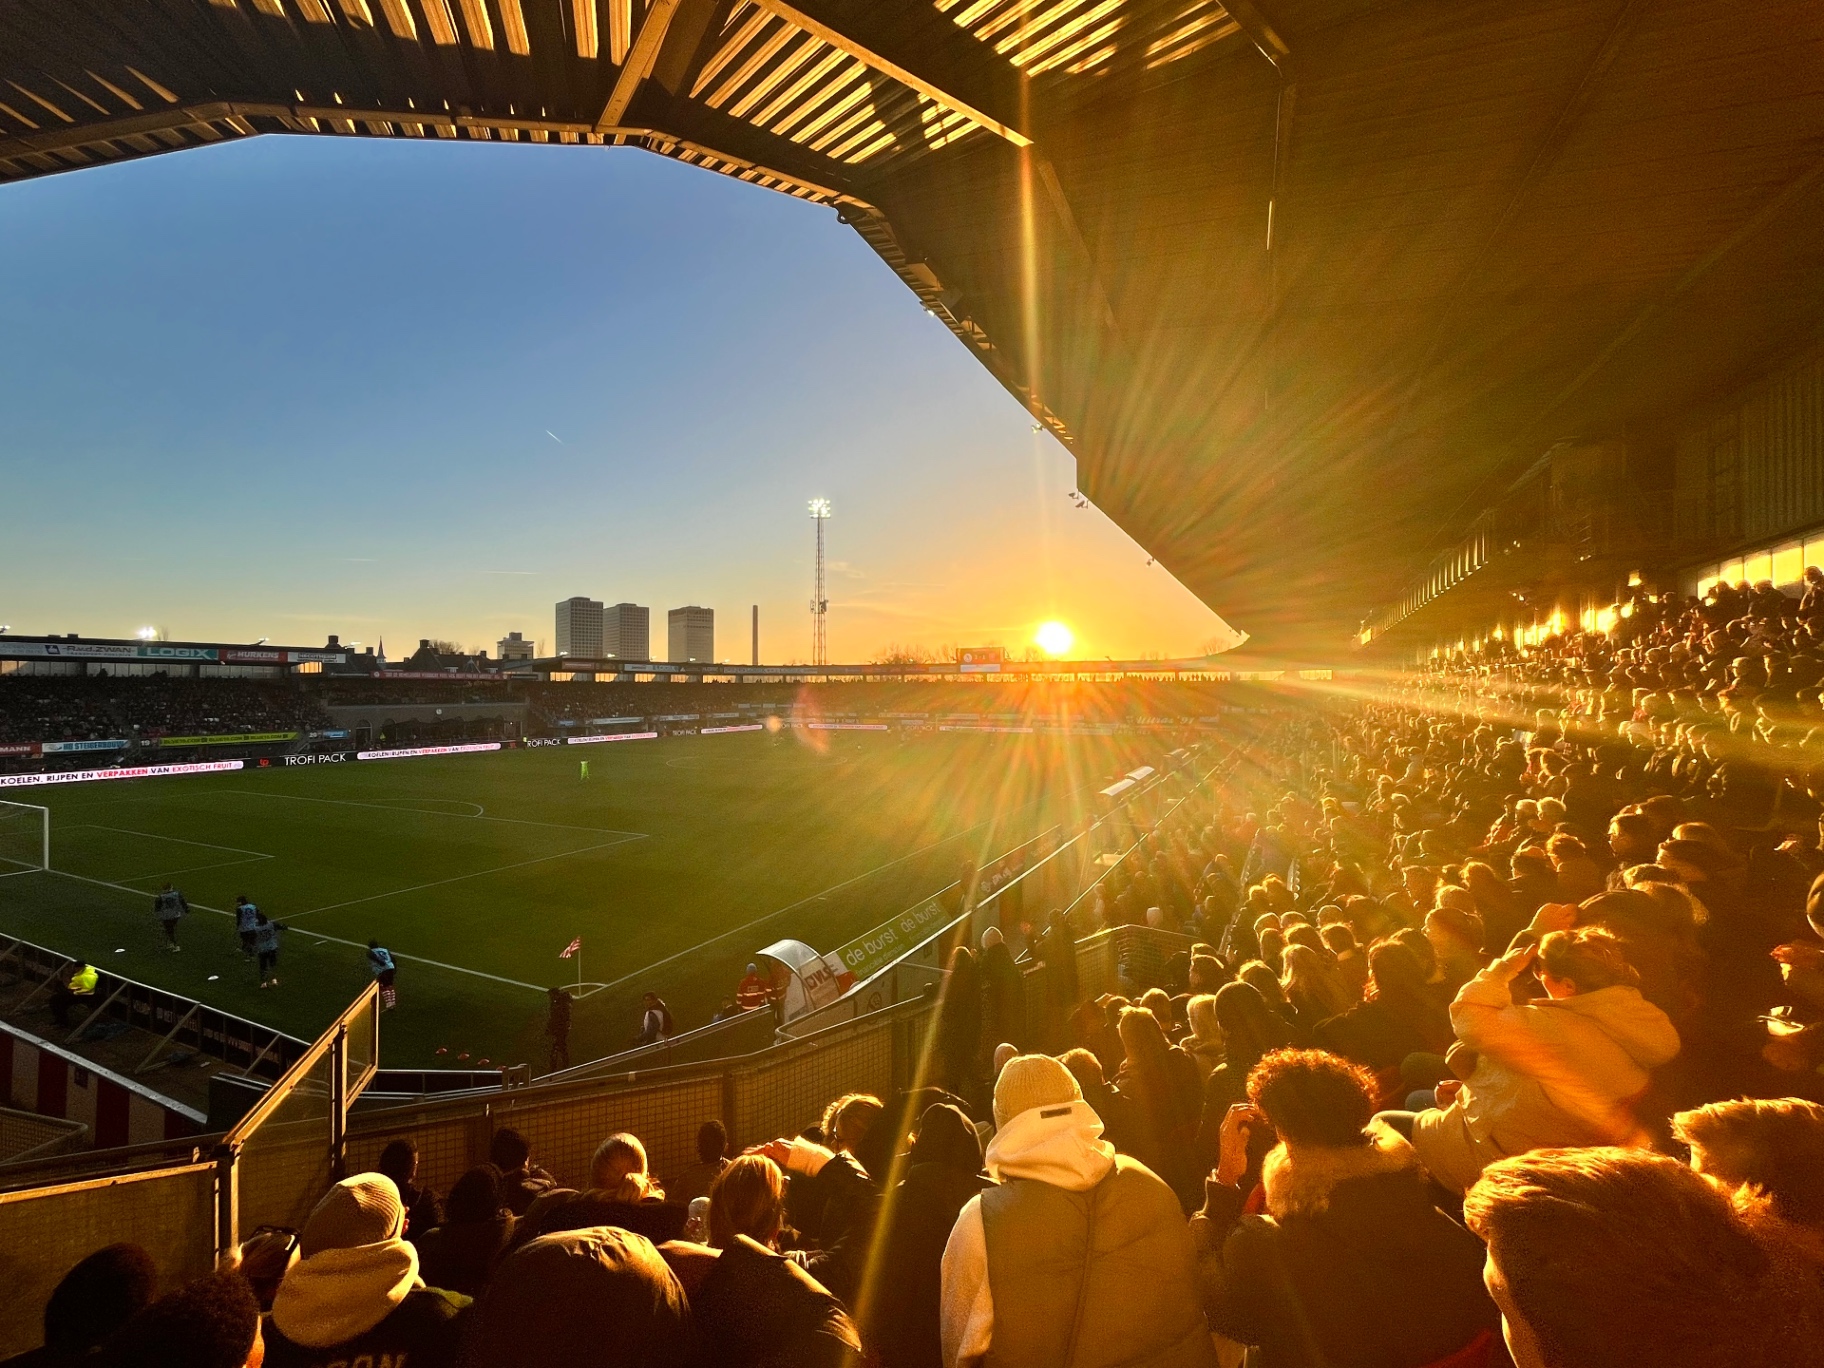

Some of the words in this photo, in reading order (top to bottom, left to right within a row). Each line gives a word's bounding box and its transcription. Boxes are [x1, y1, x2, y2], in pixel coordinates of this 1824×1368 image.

[146, 648, 211, 660] LOGIX
[285, 755, 315, 766] TROFI
[319, 753, 347, 764] PACK
[47, 774, 78, 782] RIJPEN
[97, 768, 148, 778] VERPAKKEN
[172, 763, 211, 773] EXOTISCH
[901, 918, 916, 933] de
[846, 948, 866, 966] de
